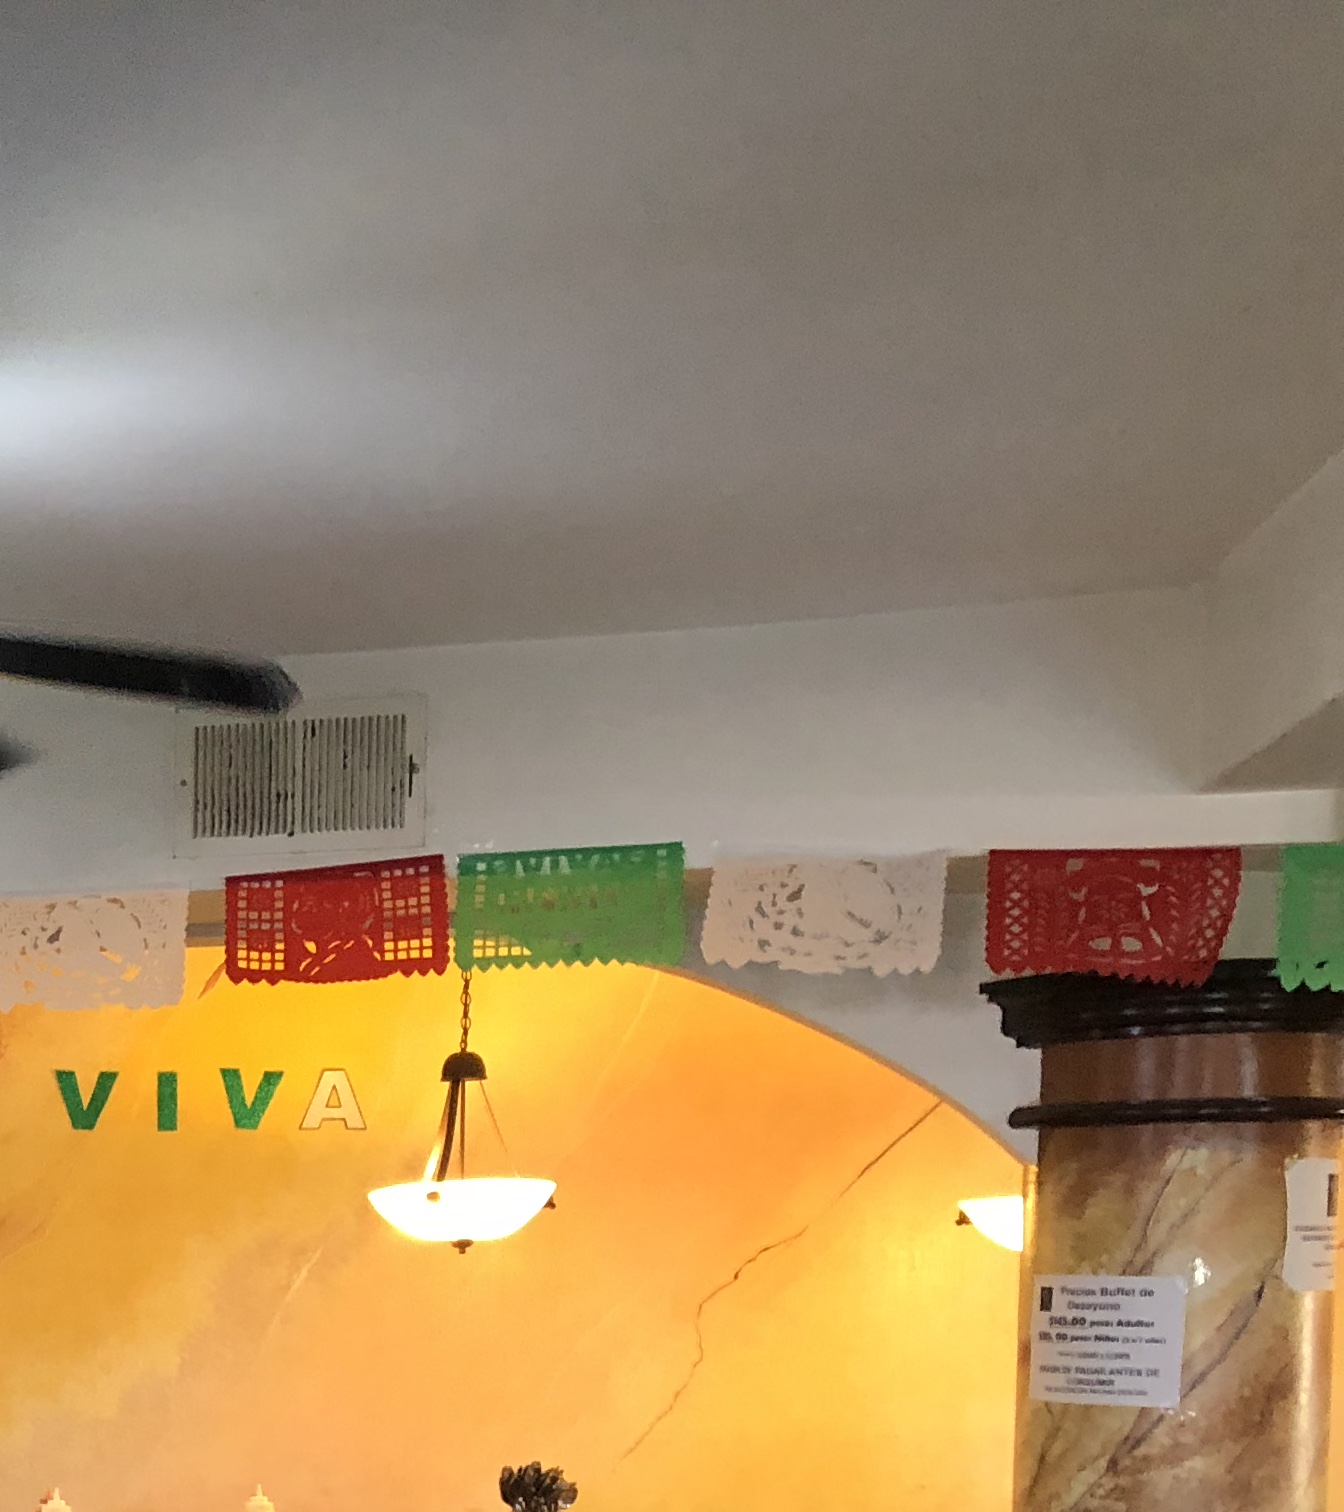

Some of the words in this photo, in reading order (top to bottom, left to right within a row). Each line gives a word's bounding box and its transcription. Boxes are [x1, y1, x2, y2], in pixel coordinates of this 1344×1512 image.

[54, 1068, 367, 1132] VIVA
[1060, 1286, 1097, 1296] Precios
[1100, 1287, 1135, 1297] Buffet
[1140, 1288, 1155, 1298] de
[1067, 1300, 1121, 1311] Desayuno
[1116, 1318, 1155, 1328] Adultos
